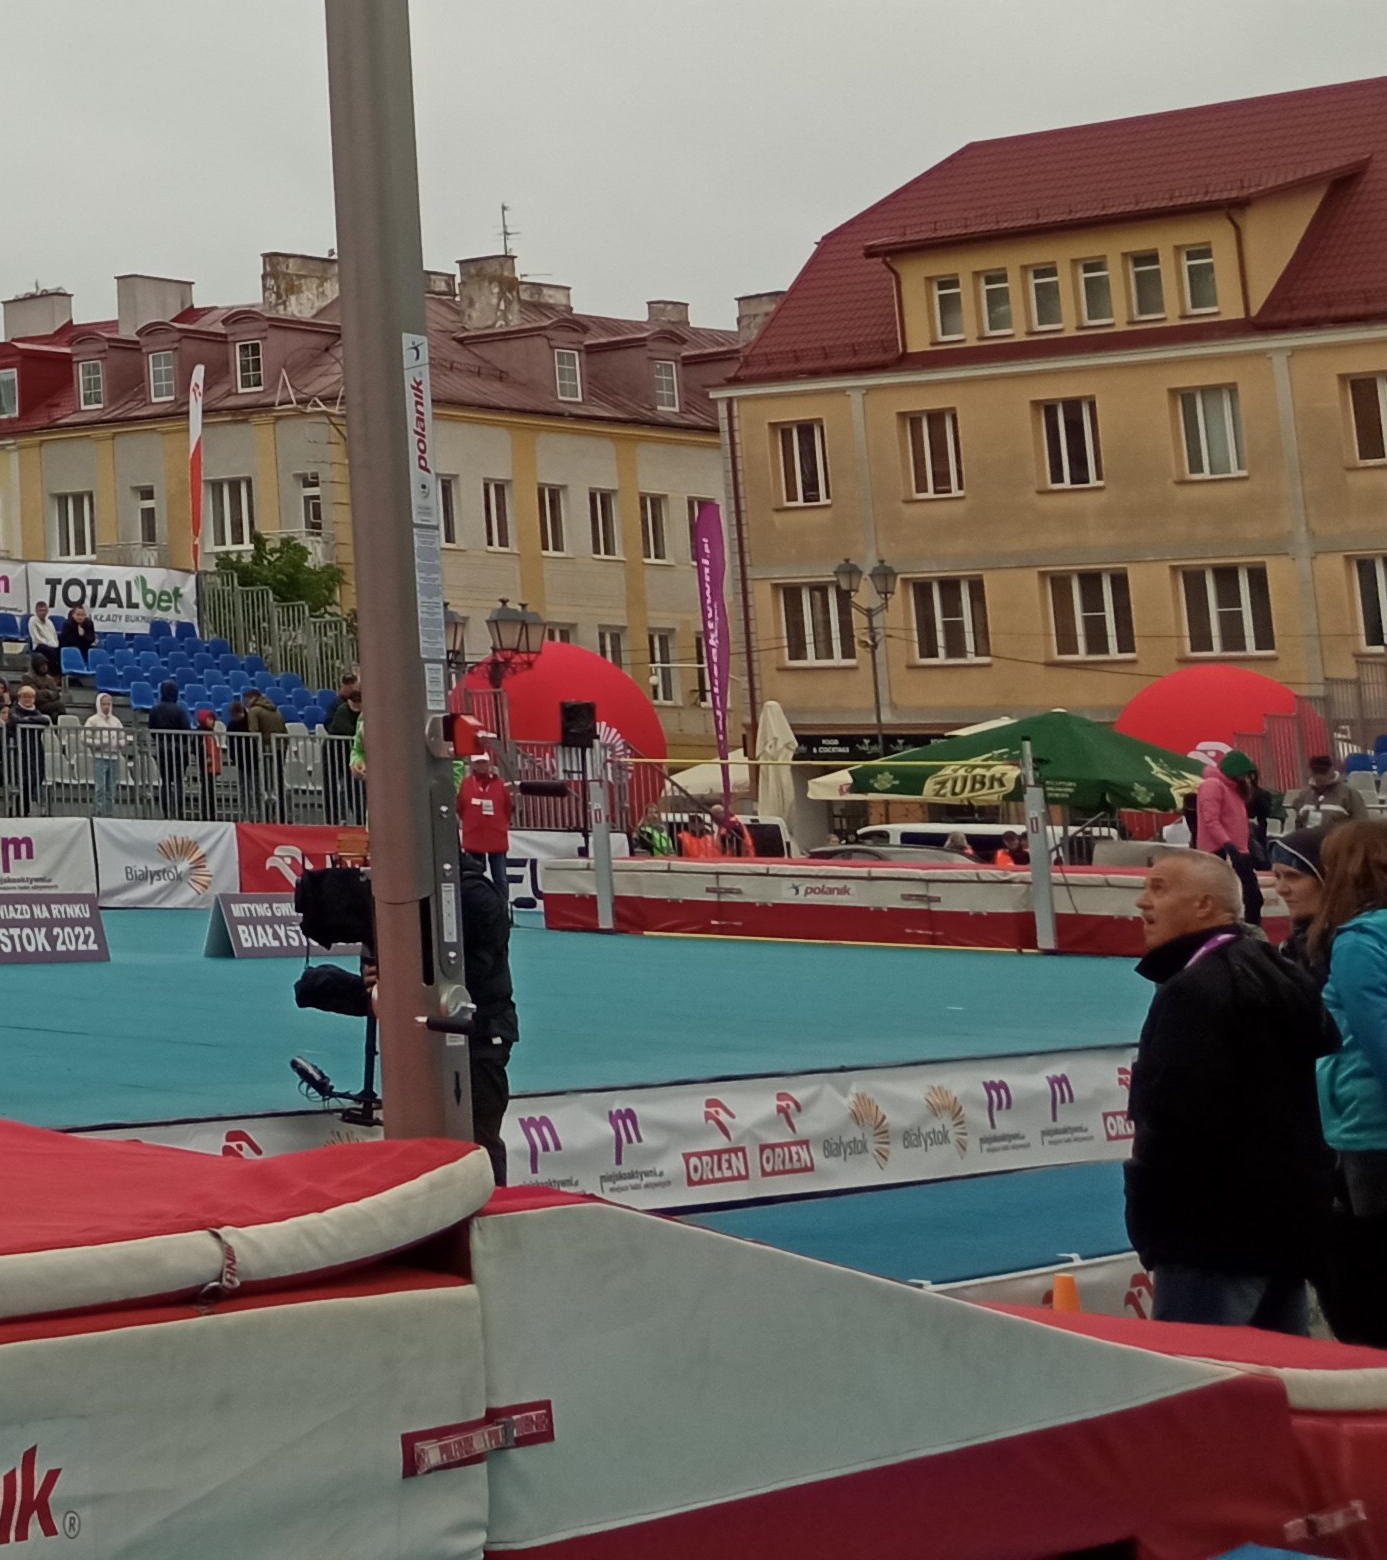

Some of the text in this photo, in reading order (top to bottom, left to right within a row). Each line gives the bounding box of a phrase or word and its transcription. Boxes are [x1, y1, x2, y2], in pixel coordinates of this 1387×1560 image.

[89, 614, 122, 623] KŁADY
[125, 865, 183, 883] Białystok
[33, 904, 50, 920] NA
[52, 903, 91, 919] RYNKU
[230, 903, 272, 917] MITYNG
[55, 927, 99, 951] 2022
[237, 924, 310, 947] BIAŁYST
[688, 1151, 745, 1181] ORLEN
[763, 1142, 811, 1170] ORLEN
